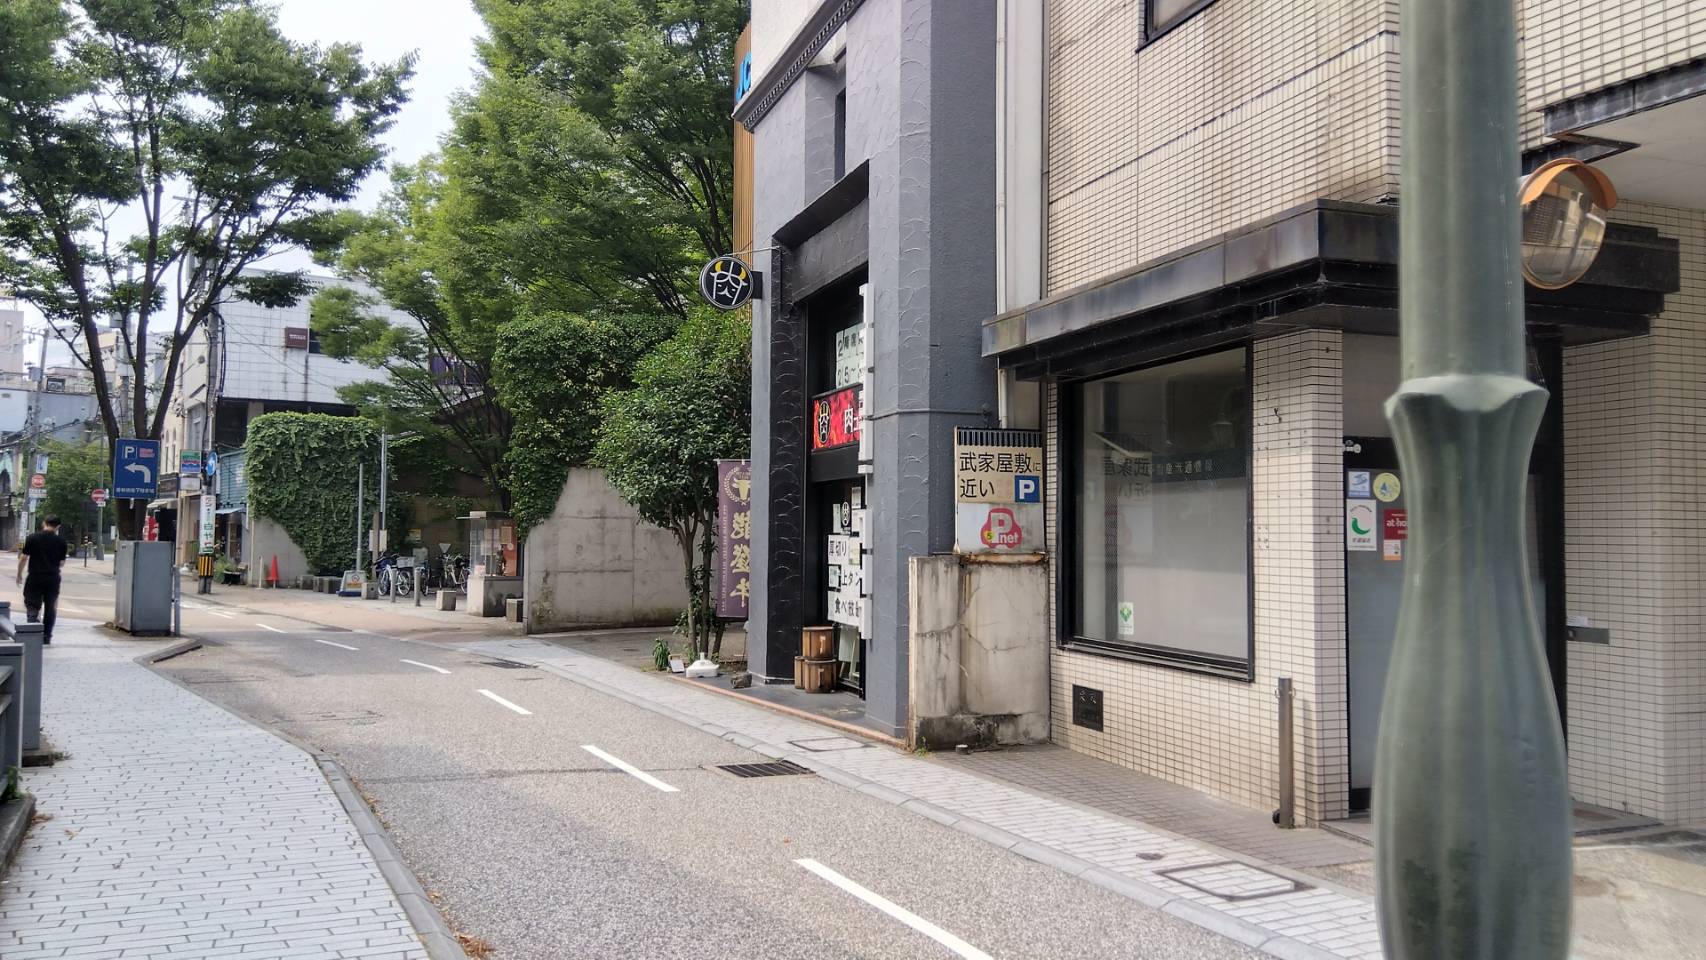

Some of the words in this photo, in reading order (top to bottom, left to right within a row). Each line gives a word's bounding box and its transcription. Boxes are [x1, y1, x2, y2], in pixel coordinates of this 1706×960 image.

[124, 446, 134, 458] P
[959, 451, 1041, 473] 武家屋敷に
[960, 478, 995, 498] 近い
[1018, 479, 1035, 500] P
[1000, 532, 1019, 544] net
[829, 539, 847, 557] 厚切り
[841, 569, 860, 586] 上タン
